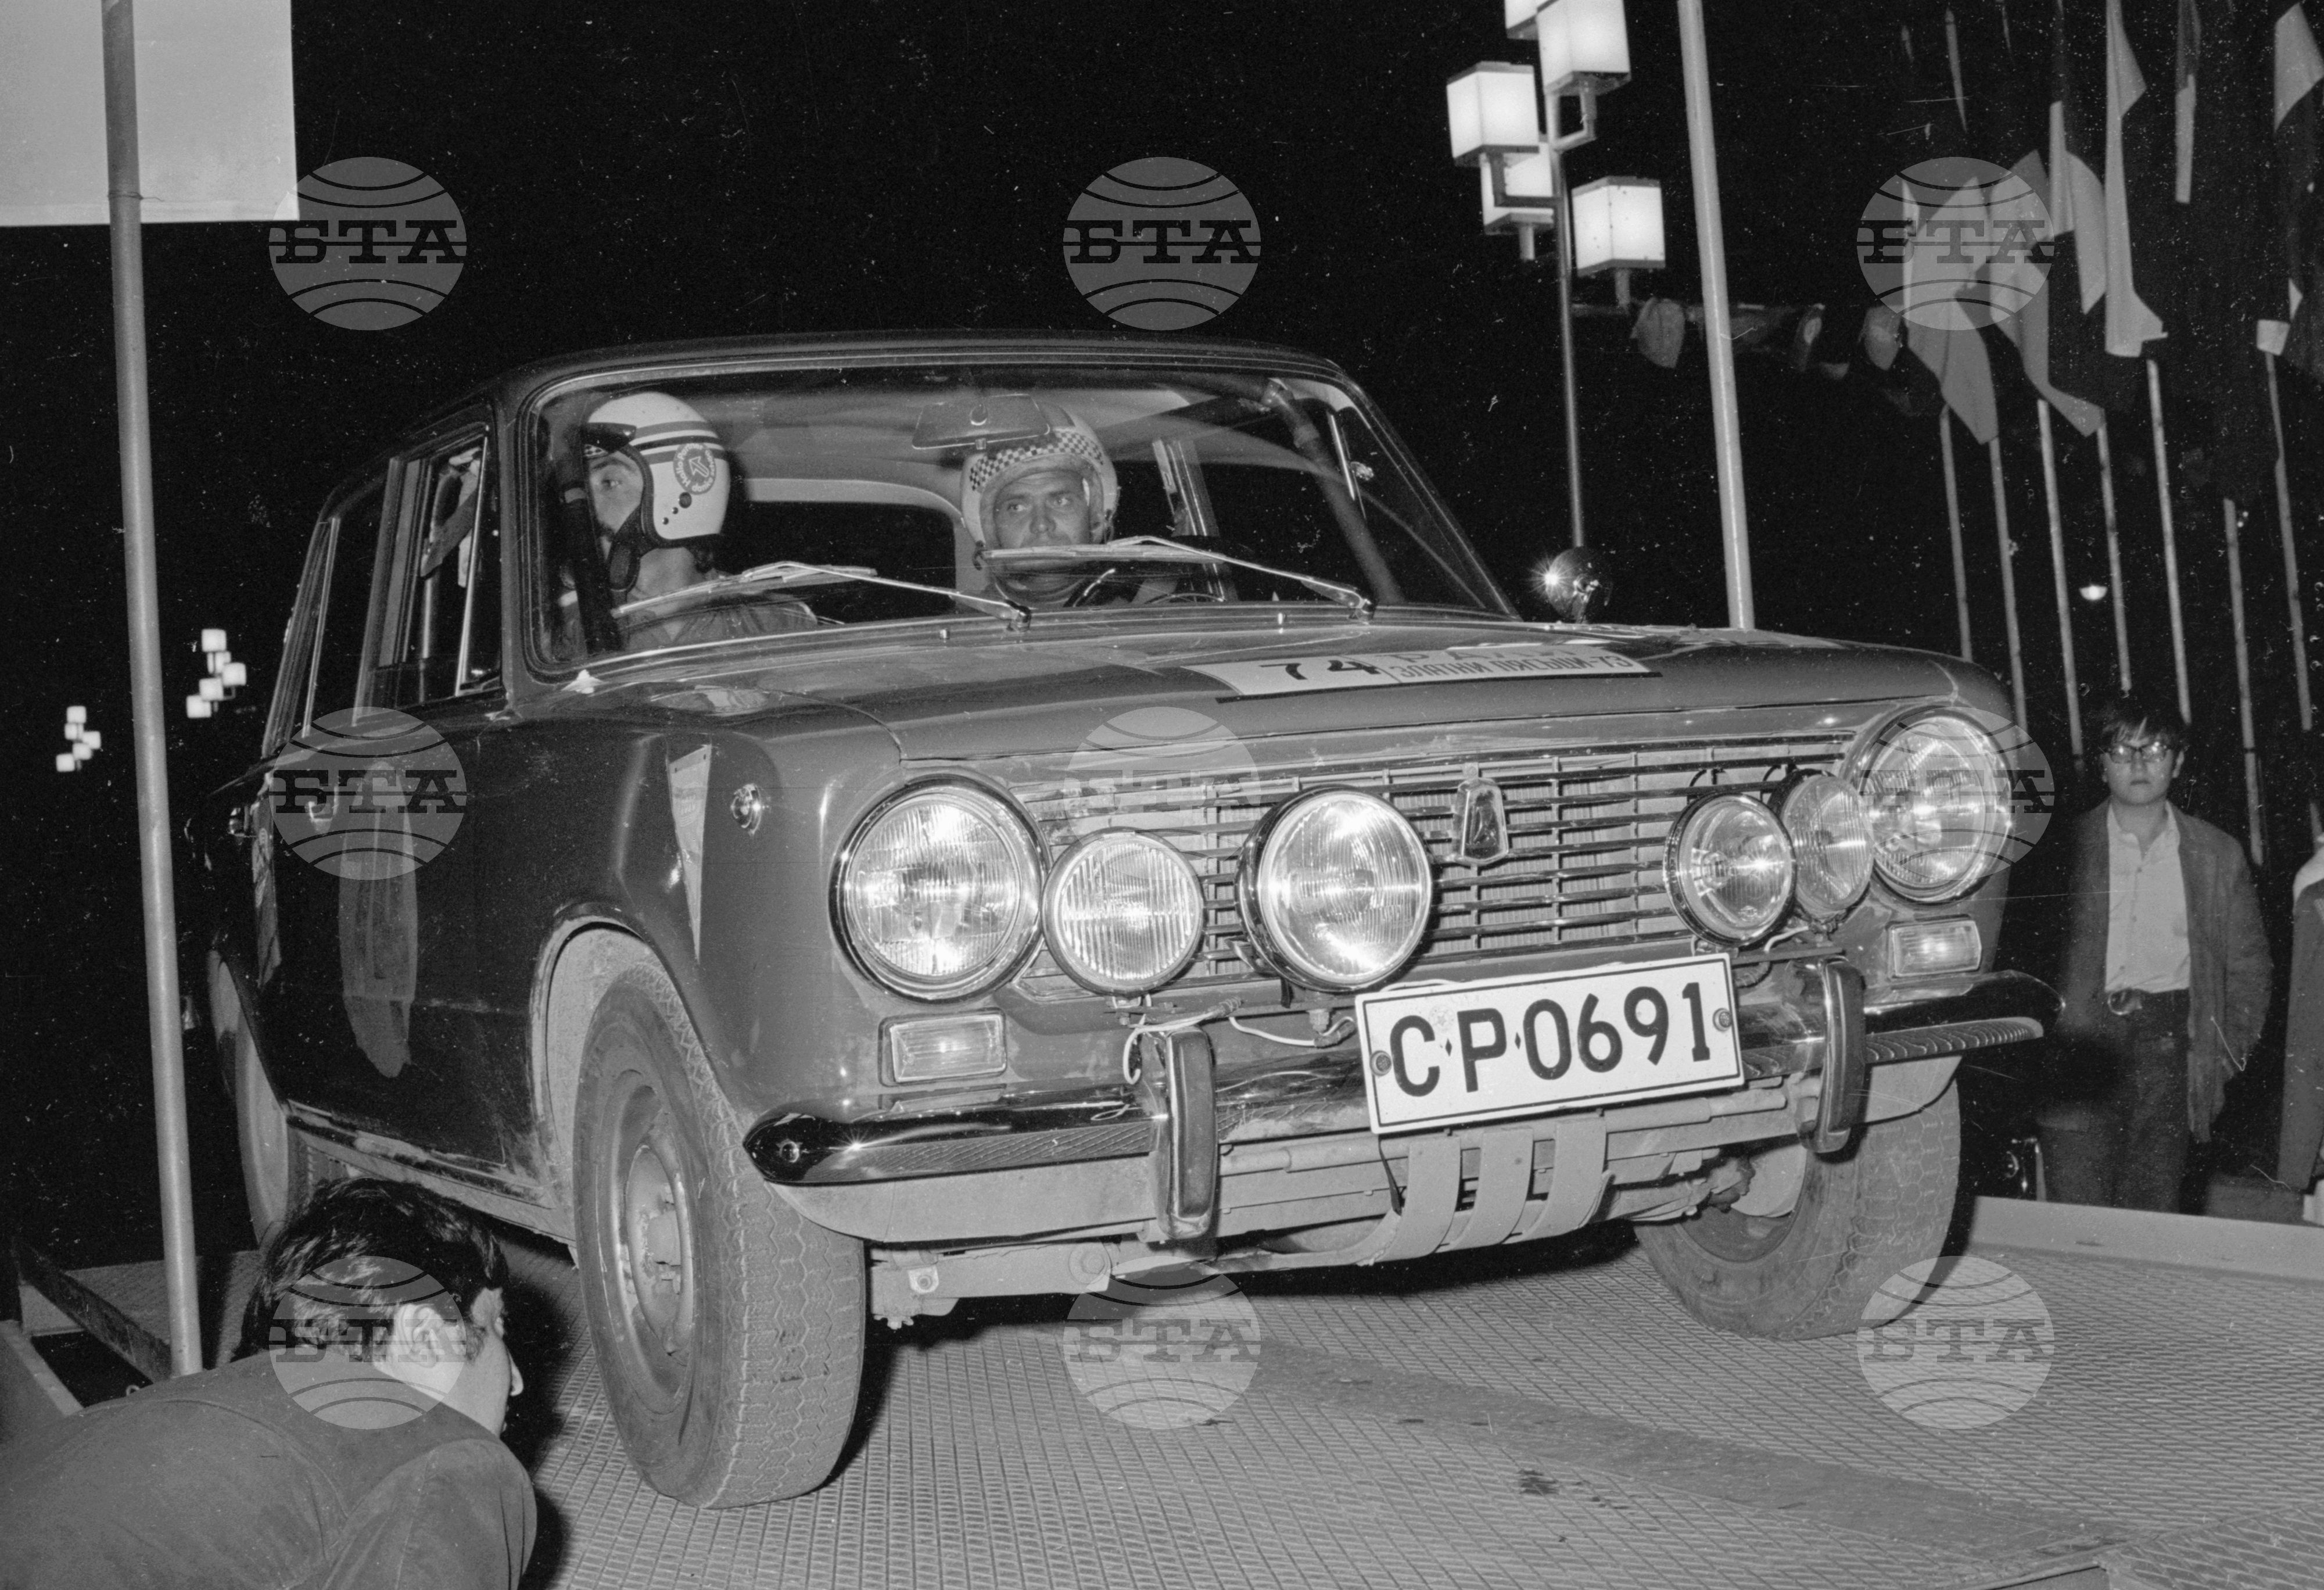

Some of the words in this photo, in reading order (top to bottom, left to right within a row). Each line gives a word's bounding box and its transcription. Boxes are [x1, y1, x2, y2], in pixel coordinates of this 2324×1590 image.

[676, 461, 691, 487] Hallo
[1259, 659, 1382, 680] 74
[1390, 661, 1493, 678] ЗЛАТНИ
